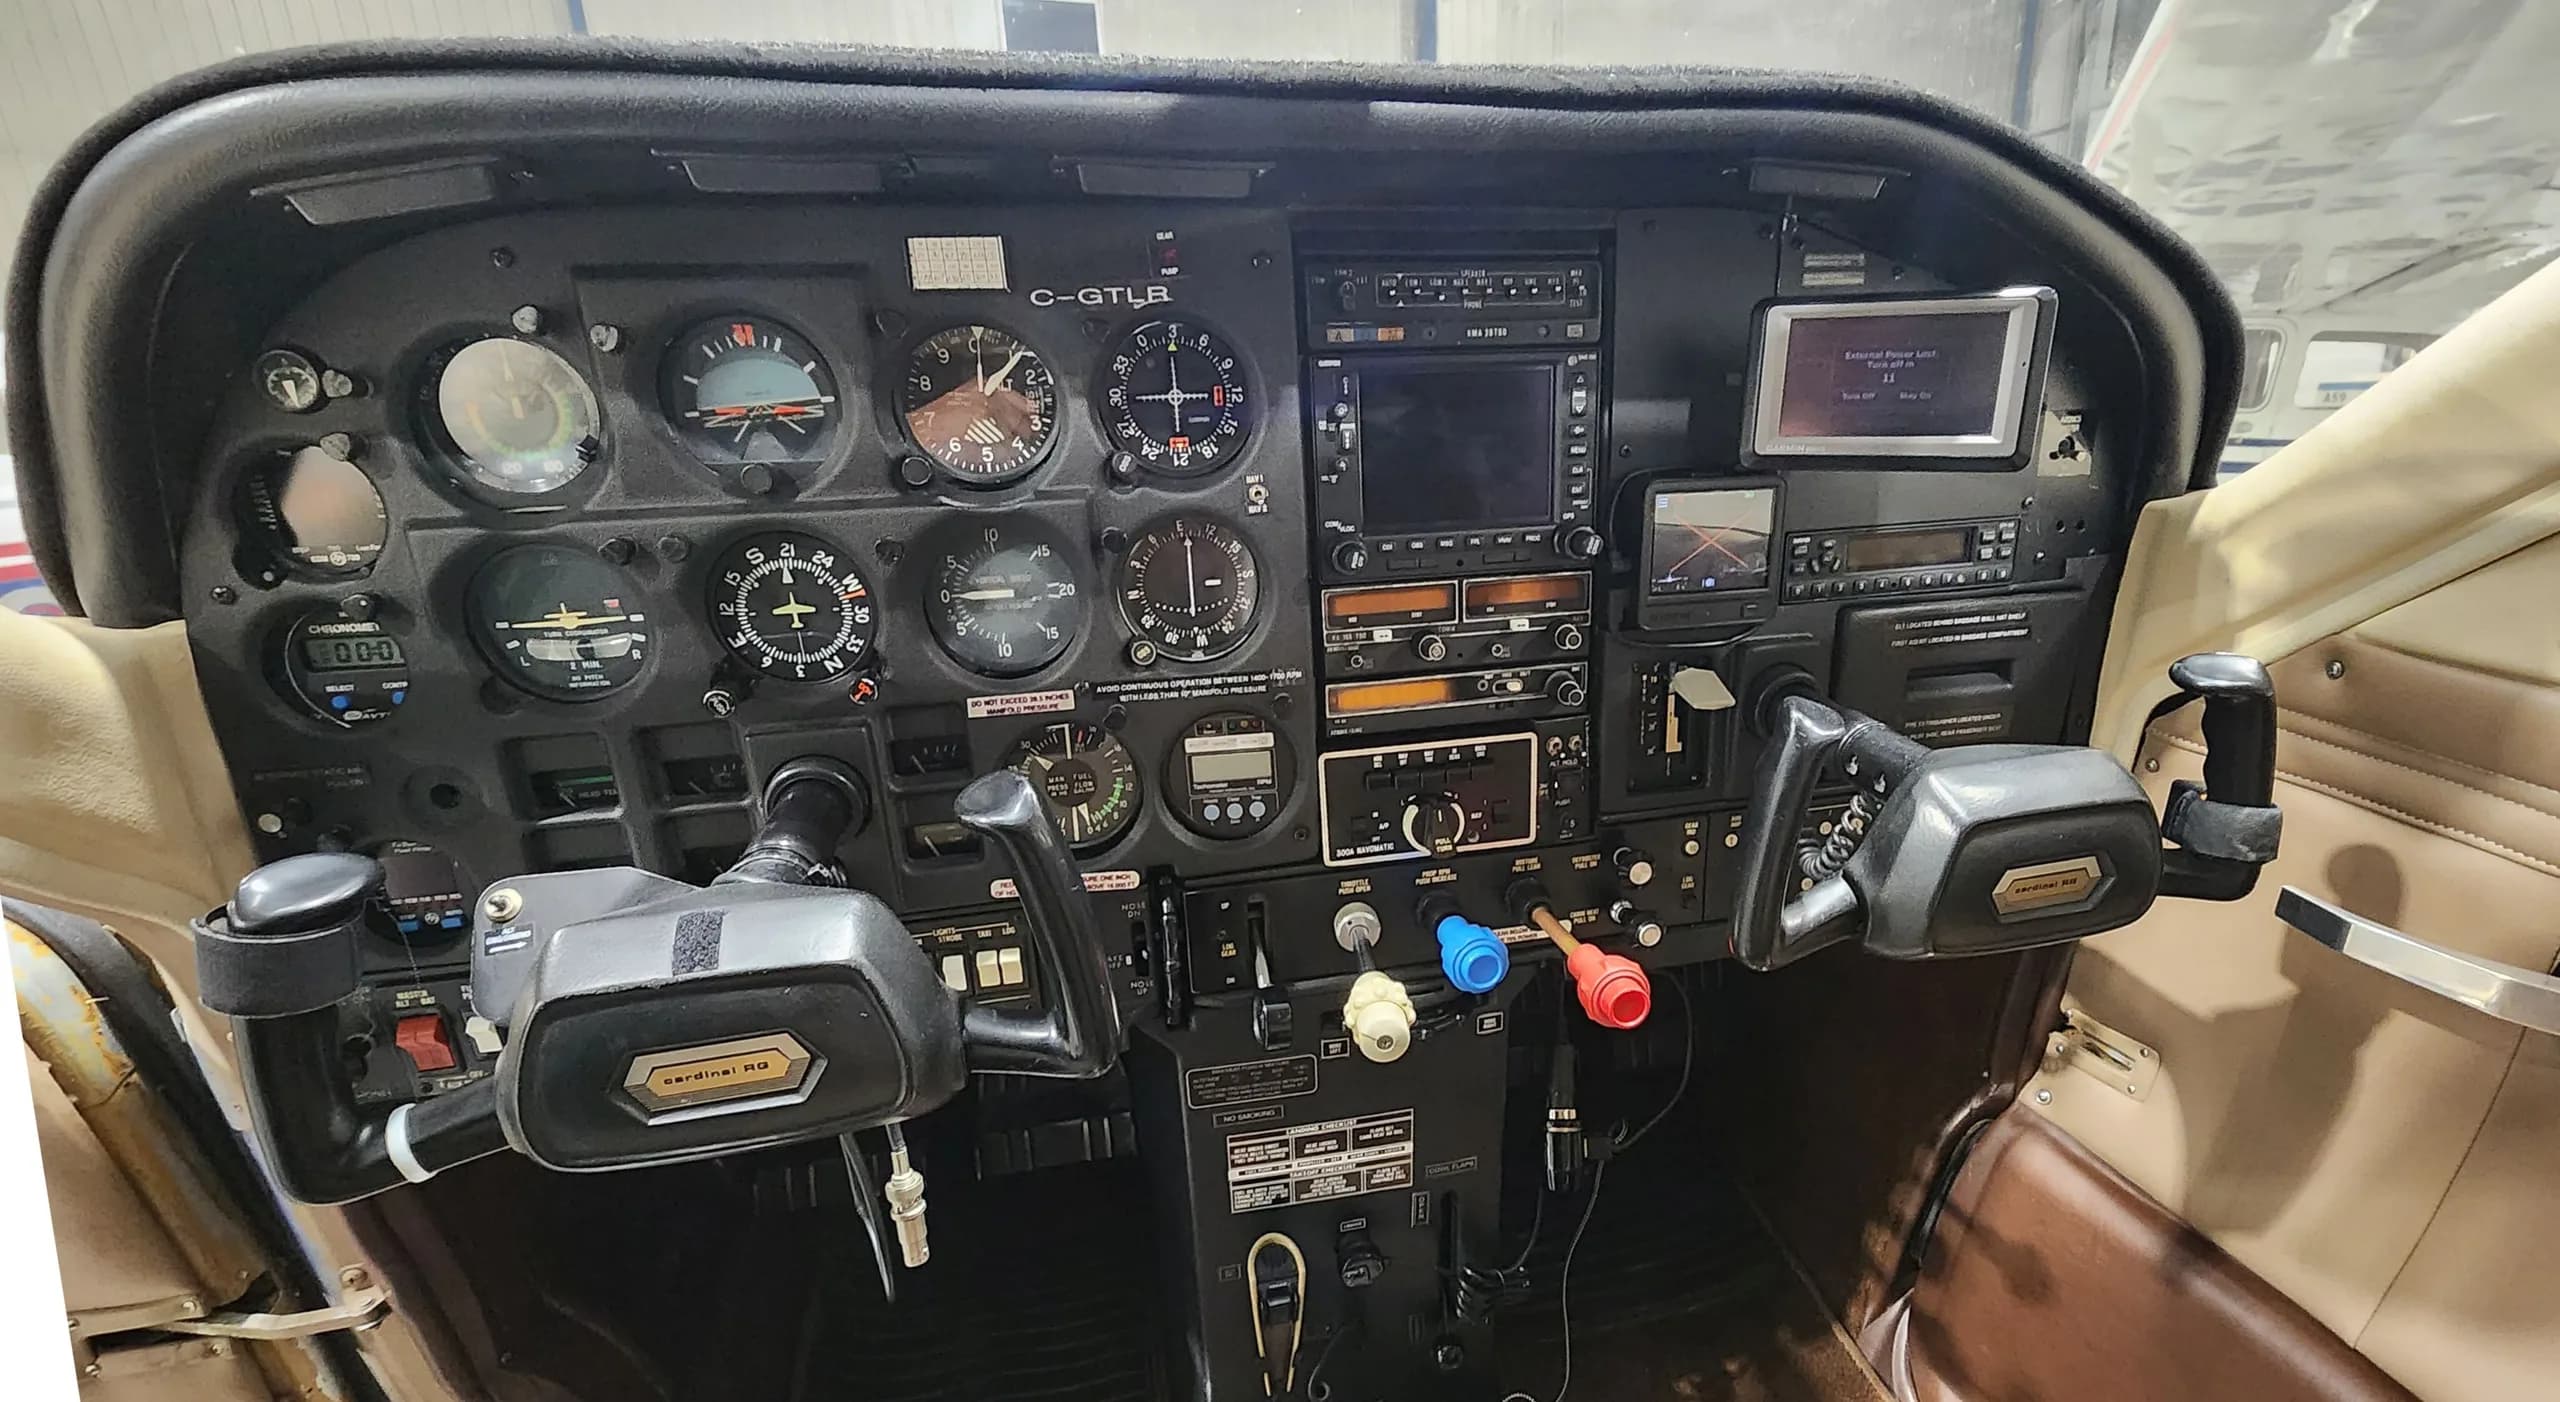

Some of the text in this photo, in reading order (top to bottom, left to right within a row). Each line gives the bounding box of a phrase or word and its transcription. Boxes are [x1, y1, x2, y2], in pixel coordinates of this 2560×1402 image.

[1030, 286, 1169, 307] C-GTLR
[1168, 324, 1177, 338] 3
[1137, 334, 1147, 348] 0
[1199, 334, 1209, 347] 6
[937, 348, 950, 364] 9
[1845, 350, 1883, 360] External
[1885, 350, 1914, 359] Power
[1113, 355, 1129, 375] 33
[1222, 358, 1233, 370] 9
[919, 375, 932, 391] 8
[1025, 369, 1037, 385] 2
[1109, 388, 1122, 407] 30
[1231, 386, 1244, 403] 12
[924, 411, 935, 428] 7
[1030, 415, 1042, 432] 3
[1117, 422, 1135, 438] 27
[1224, 419, 1238, 436] 15
[949, 437, 962, 452] 6
[1012, 436, 1024, 450] 4
[982, 447, 994, 462] 5
[1141, 445, 1159, 461] 24
[1201, 443, 1219, 459] 18
[1173, 454, 1189, 466] 21
[1175, 519, 1183, 532] E
[1205, 523, 1216, 536] 12
[984, 528, 998, 542] 10
[780, 542, 795, 557] 21
[1037, 544, 1050, 557] 15
[1229, 540, 1242, 554] 15
[745, 547, 765, 565] S
[812, 550, 835, 568] 24
[947, 555, 957, 569] 5
[1130, 560, 1141, 569] 3
[724, 570, 741, 587] 15
[1243, 569, 1254, 578] S
[842, 573, 863, 592] W
[1058, 583, 1076, 596] 20
[940, 589, 950, 604] 0
[1127, 589, 1140, 600] N
[719, 602, 734, 616] 12
[854, 605, 870, 624] 30
[956, 622, 967, 636] 5
[1046, 627, 1060, 640] 15
[727, 631, 748, 649] E
[845, 634, 865, 654] 33
[1165, 631, 1180, 645] 30
[1197, 635, 1209, 648] W
[631, 649, 642, 660] R
[998, 643, 1013, 657] 10
[520, 656, 531, 667] L
[761, 656, 773, 668] 6
[823, 655, 844, 674] N
[795, 664, 806, 678] 3
[1096, 684, 1120, 694] AVOID
[1121, 681, 1169, 692] CONTINUOUS
[1170, 678, 1212, 688] OPERATION
[1213, 675, 1249, 685] BETWEEN
[1160, 691, 1179, 699] THAN
[1230, 685, 1267, 694] PRESSURE
[1000, 695, 1028, 705] EXCEED
[1087, 826, 1094, 834] 0
[2015, 881, 2058, 893] cardinal
[933, 927, 956, 936] LIGHTS
[977, 929, 992, 938] TAXI
[664, 1061, 769, 1085] cardinal RG
[1224, 1109, 1275, 1122] NO SMOKING
[1287, 1119, 1356, 1135] LANDING CHECKLIST
